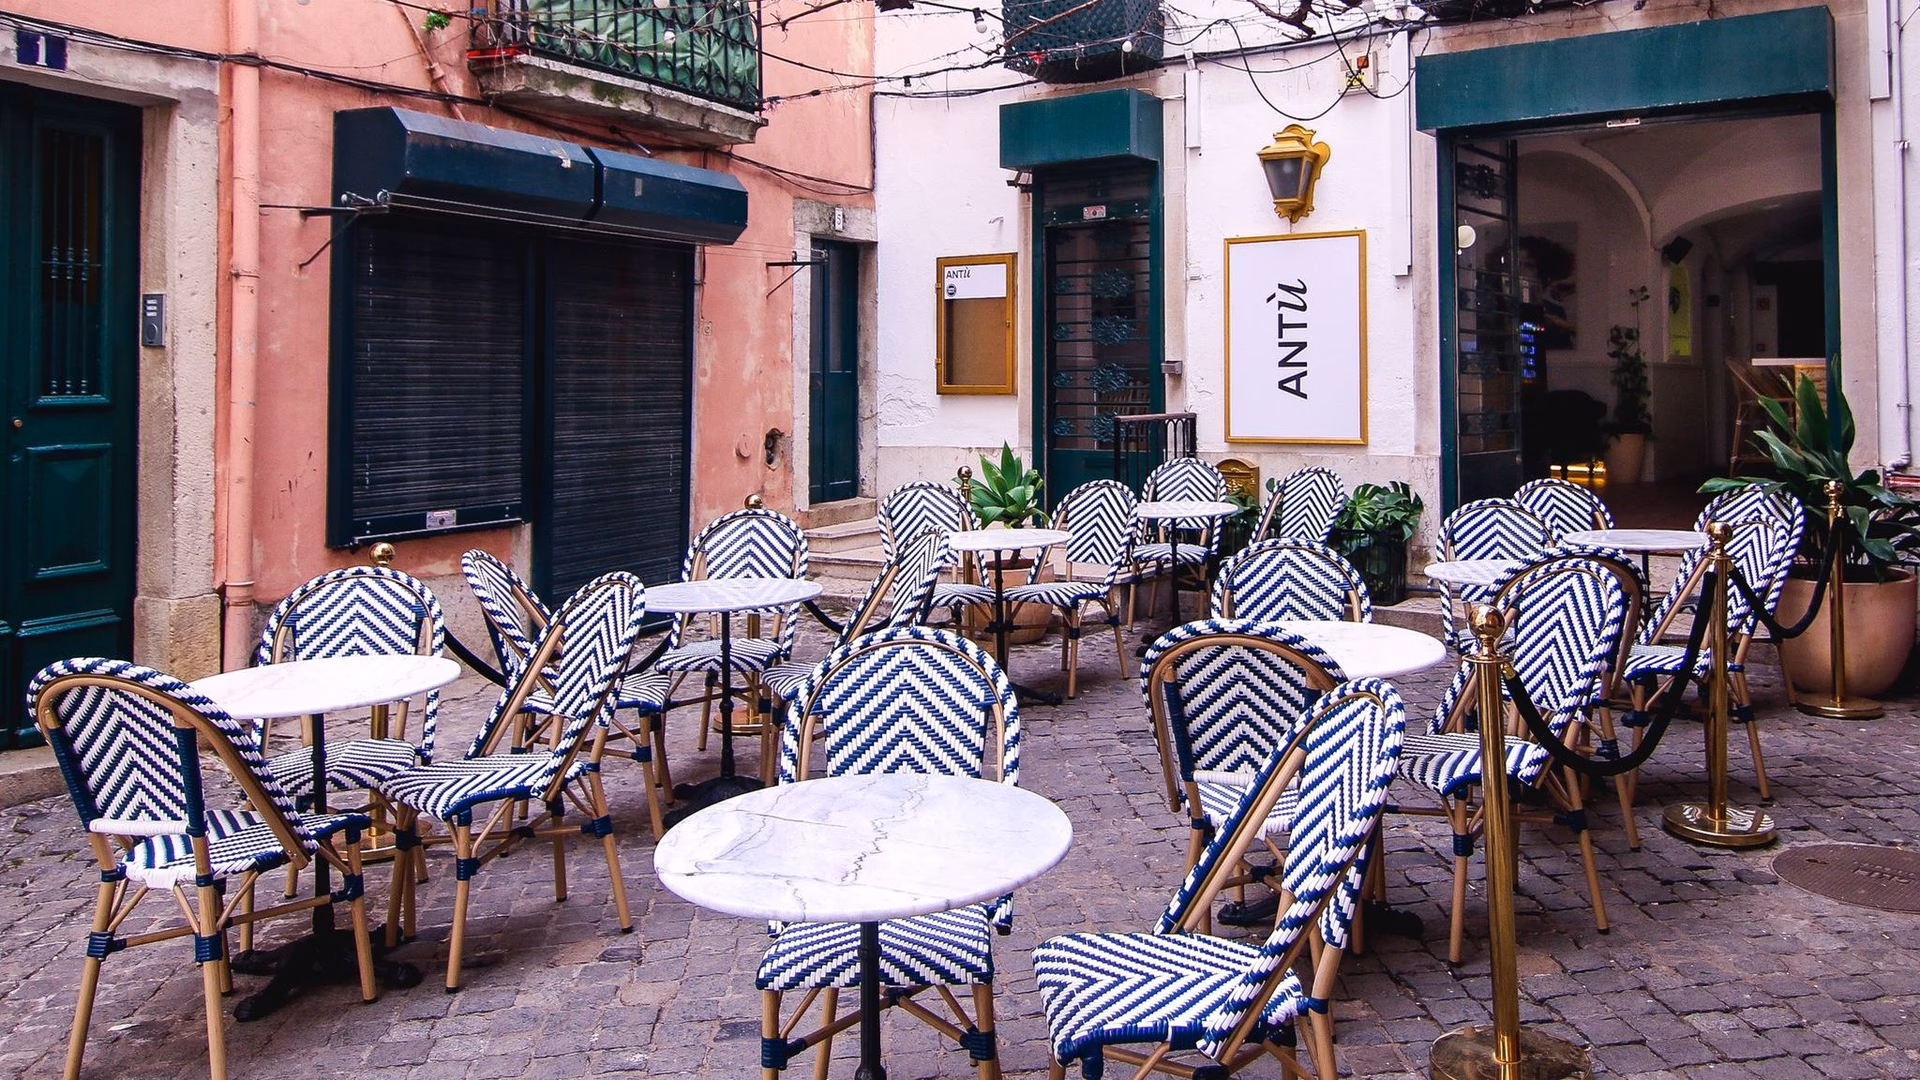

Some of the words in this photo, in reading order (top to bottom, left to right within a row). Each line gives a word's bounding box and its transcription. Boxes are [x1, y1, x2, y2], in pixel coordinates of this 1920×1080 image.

[35, 35, 48, 66] 1
[836, 213, 842, 226] 5
[1266, 278, 1308, 400] ANTù
